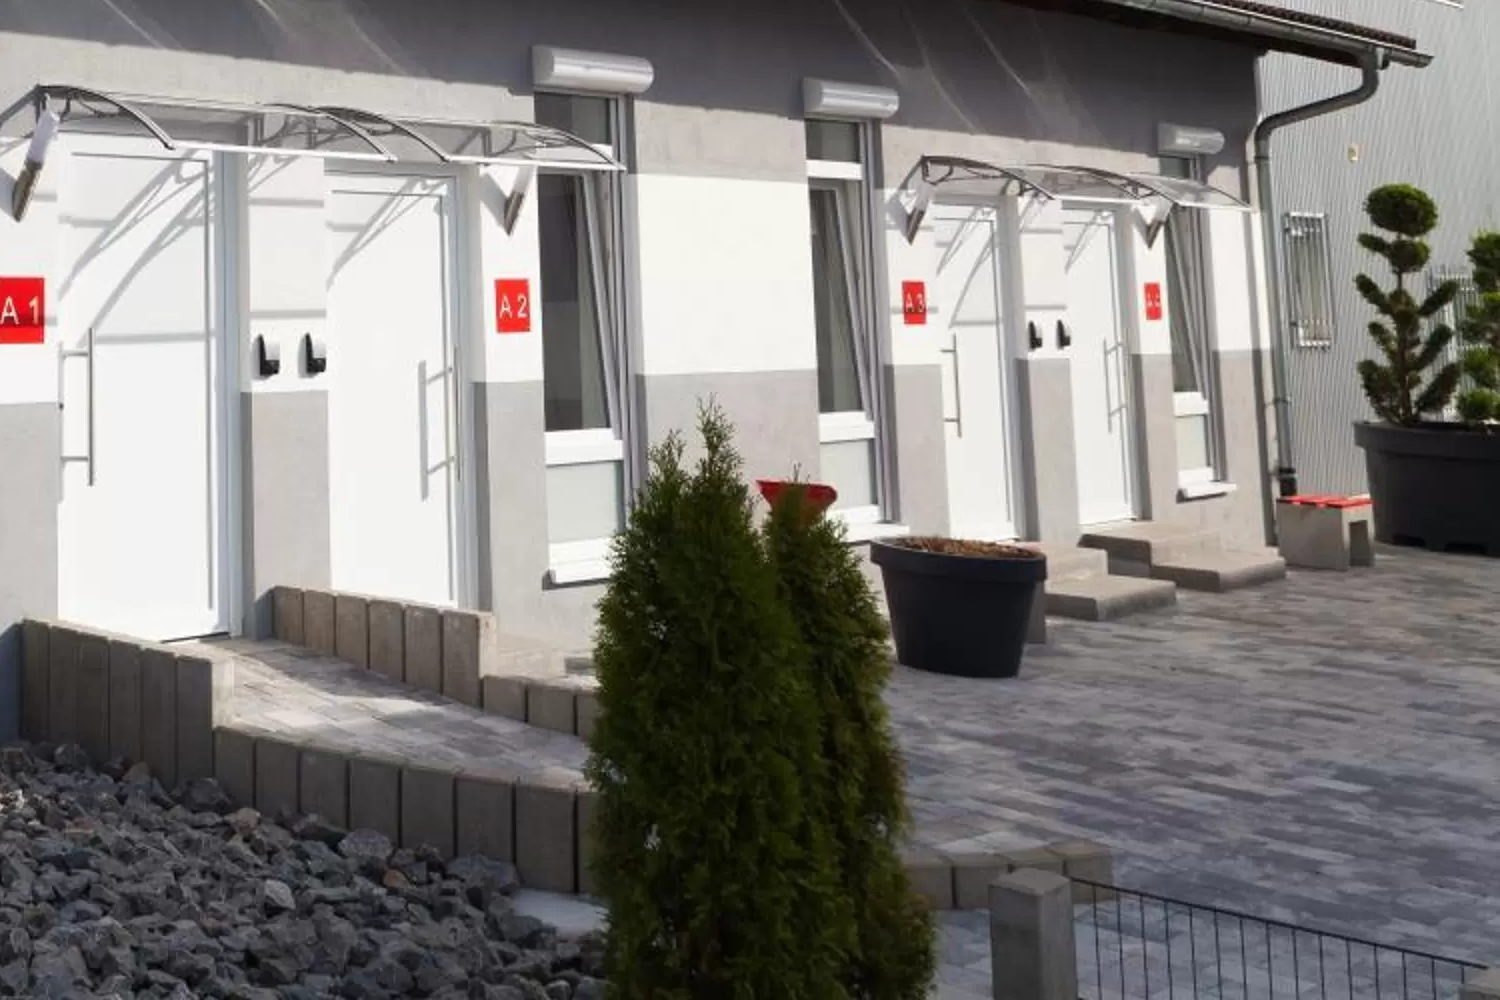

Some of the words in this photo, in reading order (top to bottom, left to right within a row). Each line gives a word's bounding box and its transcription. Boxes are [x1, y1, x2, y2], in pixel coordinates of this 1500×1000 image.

[0, 295, 20, 325] A
[28, 295, 40, 325] 1
[499, 292, 513, 319] A
[516, 292, 528, 319] 2
